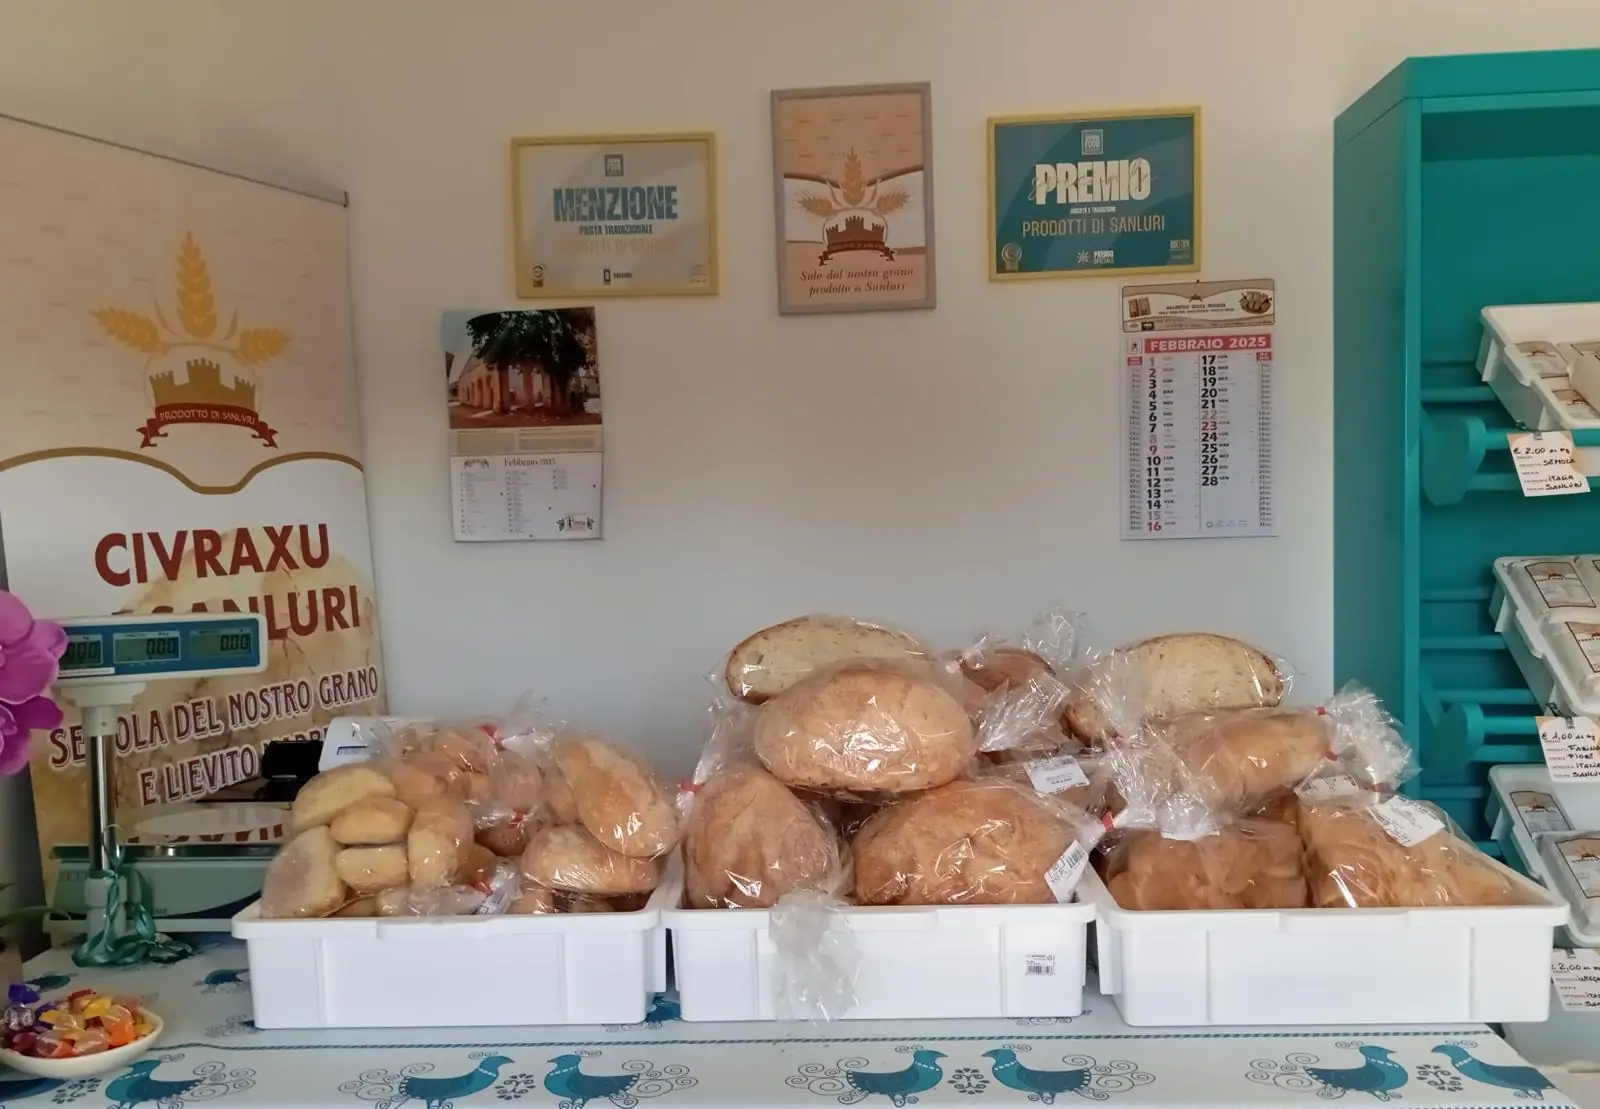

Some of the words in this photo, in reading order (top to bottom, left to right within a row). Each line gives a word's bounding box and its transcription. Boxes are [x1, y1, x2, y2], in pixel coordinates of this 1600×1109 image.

[1035, 157, 1150, 205] PREMIO
[553, 185, 678, 222] MENZIONE
[579, 225, 602, 236] PASTA
[605, 224, 653, 235] TRADIZIONALE
[1022, 219, 1086, 238] PRODOTTI
[1092, 218, 1104, 234] DI
[1109, 215, 1165, 232] SANLURI
[800, 269, 822, 281] Solo
[847, 268, 878, 279] nostro
[882, 267, 914, 280] grano
[809, 283, 851, 298] prodotto
[866, 281, 906, 292] Sanluri
[1150, 339, 1223, 351] FEBBRAIO
[1229, 337, 1266, 348] 2025
[1202, 355, 1216, 365] 17
[1149, 368, 1156, 378] 2
[1202, 366, 1216, 376] 18
[1149, 380, 1156, 389] 3
[1202, 378, 1216, 386] 19
[1149, 390, 1157, 400] 4
[1201, 388, 1218, 398] 20
[1149, 402, 1157, 410] 5
[1202, 400, 1216, 409] 21
[160, 409, 209, 421] PRODOTTO
[211, 410, 220, 419] DI
[1149, 412, 1157, 422] 6
[1149, 424, 1156, 432] 7
[1202, 422, 1218, 431] 23
[1202, 432, 1218, 442] 24
[1149, 445, 1157, 455] 9
[1202, 444, 1218, 454] 25
[1147, 456, 1161, 466] 10
[1202, 455, 1218, 464] 26
[1543, 458, 1576, 466] SEMOLA
[1147, 468, 1159, 476] 11
[1202, 466, 1218, 476] 27
[1147, 478, 1161, 488] 12
[1202, 477, 1218, 486] 28
[1147, 489, 1161, 498] 13
[1147, 500, 1162, 510] 14
[1148, 522, 1162, 532] 16
[95, 523, 330, 587] CIVRAXU
[150, 585, 361, 641] LURI
[50, 710, 168, 765] SEOLA
[174, 702, 221, 741] DEL
[228, 680, 312, 727] NOSTRO
[319, 667, 379, 706] GRANO
[140, 771, 157, 806] E
[168, 748, 255, 799] LIEVITO
